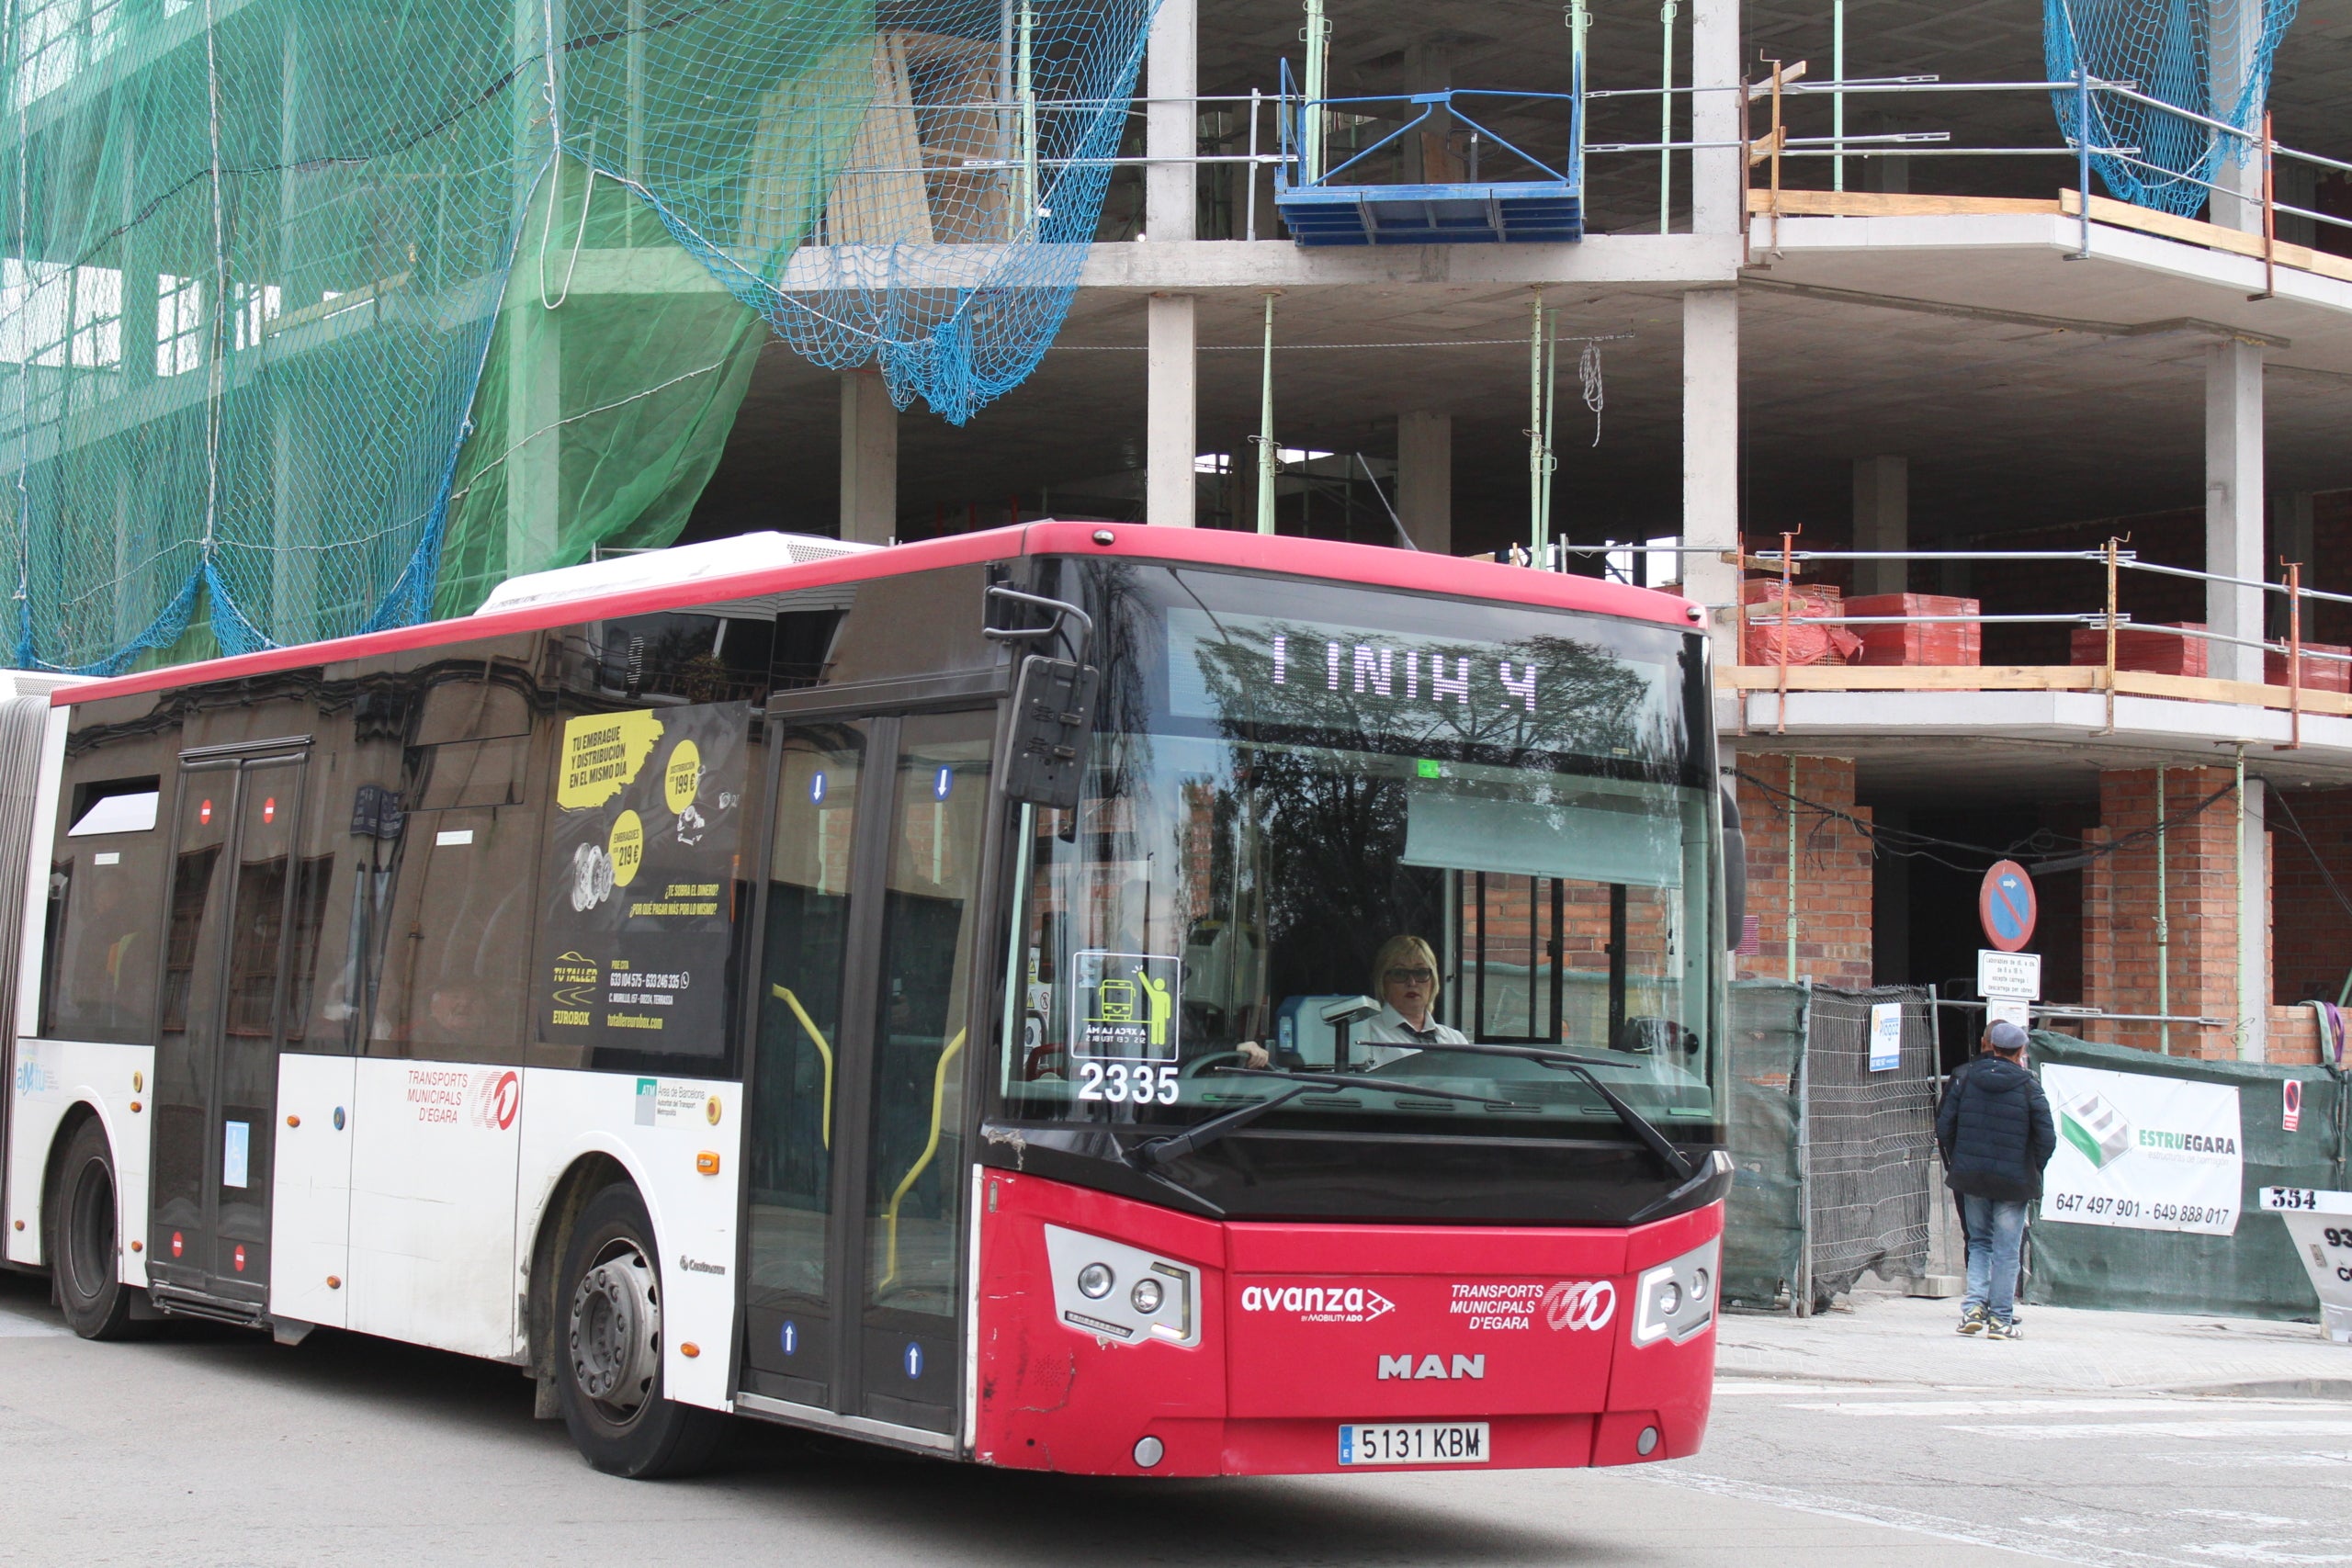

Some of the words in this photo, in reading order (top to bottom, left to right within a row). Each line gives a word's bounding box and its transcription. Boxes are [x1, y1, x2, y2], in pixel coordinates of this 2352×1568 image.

[573, 737, 581, 751] TU
[582, 726, 621, 750] EMBRAGUE
[571, 756, 575, 770] Y
[577, 741, 626, 769] DISTRIBUCIÓN
[570, 773, 579, 788] EN
[580, 770, 588, 785] EL
[589, 764, 613, 784] MISMO
[675, 774, 689, 795] 199
[618, 845, 632, 866] 219
[553, 967, 566, 982] TU
[566, 967, 597, 983] TALLER
[552, 1010, 590, 1025] EUROBOX
[408, 1070, 468, 1088] TRANSPORTS
[1078, 1062, 1180, 1105] 2335
[407, 1089, 462, 1106] MUNICIPALS
[641, 1085, 656, 1096] ATM
[419, 1107, 458, 1123] D'EGARA
[2139, 1129, 2236, 1155] ESTRUEGARA
[2056, 1193, 2084, 1212] 647
[2086, 1196, 2113, 1214] 497
[2116, 1200, 2140, 1217] 901
[2154, 1202, 2177, 1221] 649
[2179, 1205, 2202, 1223] 888
[2205, 1207, 2229, 1224] 017
[2272, 1189, 2316, 1210] 354
[1241, 1286, 1363, 1312] avanza
[1451, 1284, 1544, 1298] TRANSPORTS
[1450, 1301, 1535, 1314] MUNICIPALS
[1469, 1316, 1530, 1330] D'EGARA
[1377, 1354, 1485, 1380] MAN
[1342, 1450, 1350, 1458] E
[1363, 1428, 1422, 1459] 5131
[1433, 1427, 1480, 1458] KBM
